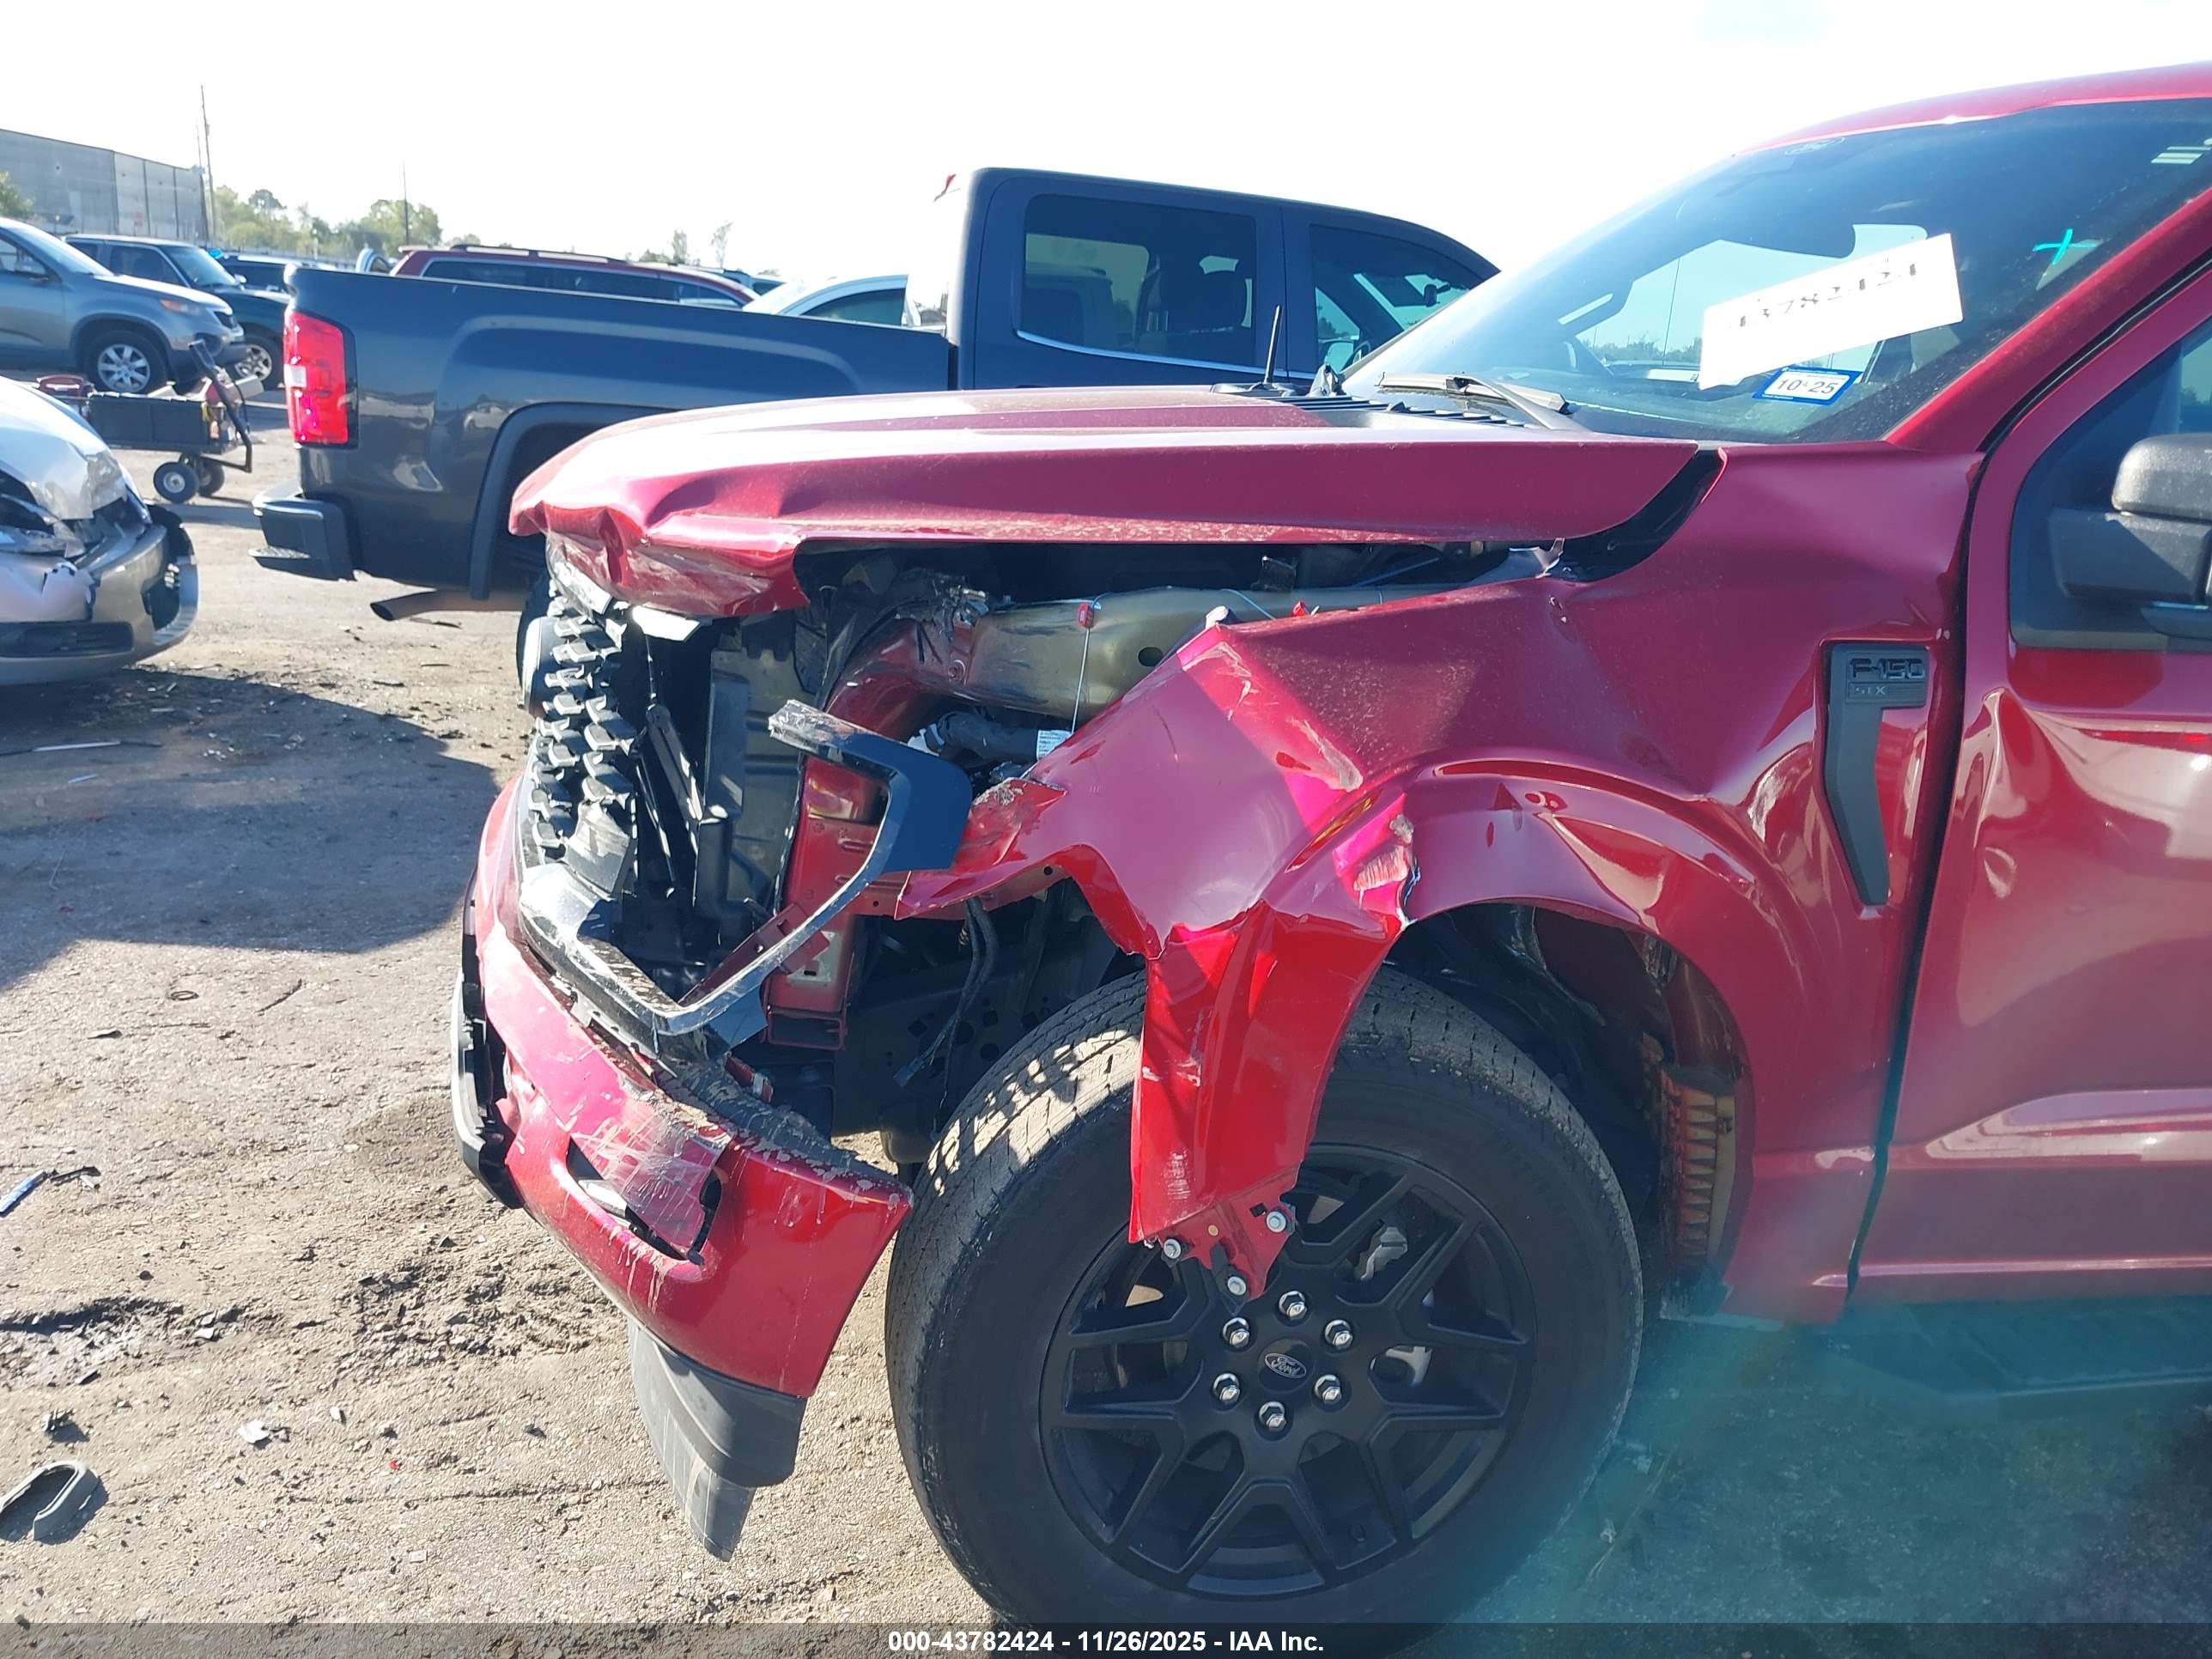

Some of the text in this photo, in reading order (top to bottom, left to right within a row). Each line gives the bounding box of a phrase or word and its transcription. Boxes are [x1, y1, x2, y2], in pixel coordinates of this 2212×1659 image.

[1777, 378, 1839, 395] 10 25
[1849, 658, 1925, 680] F-150
[1269, 1355, 1303, 1376] Ford
